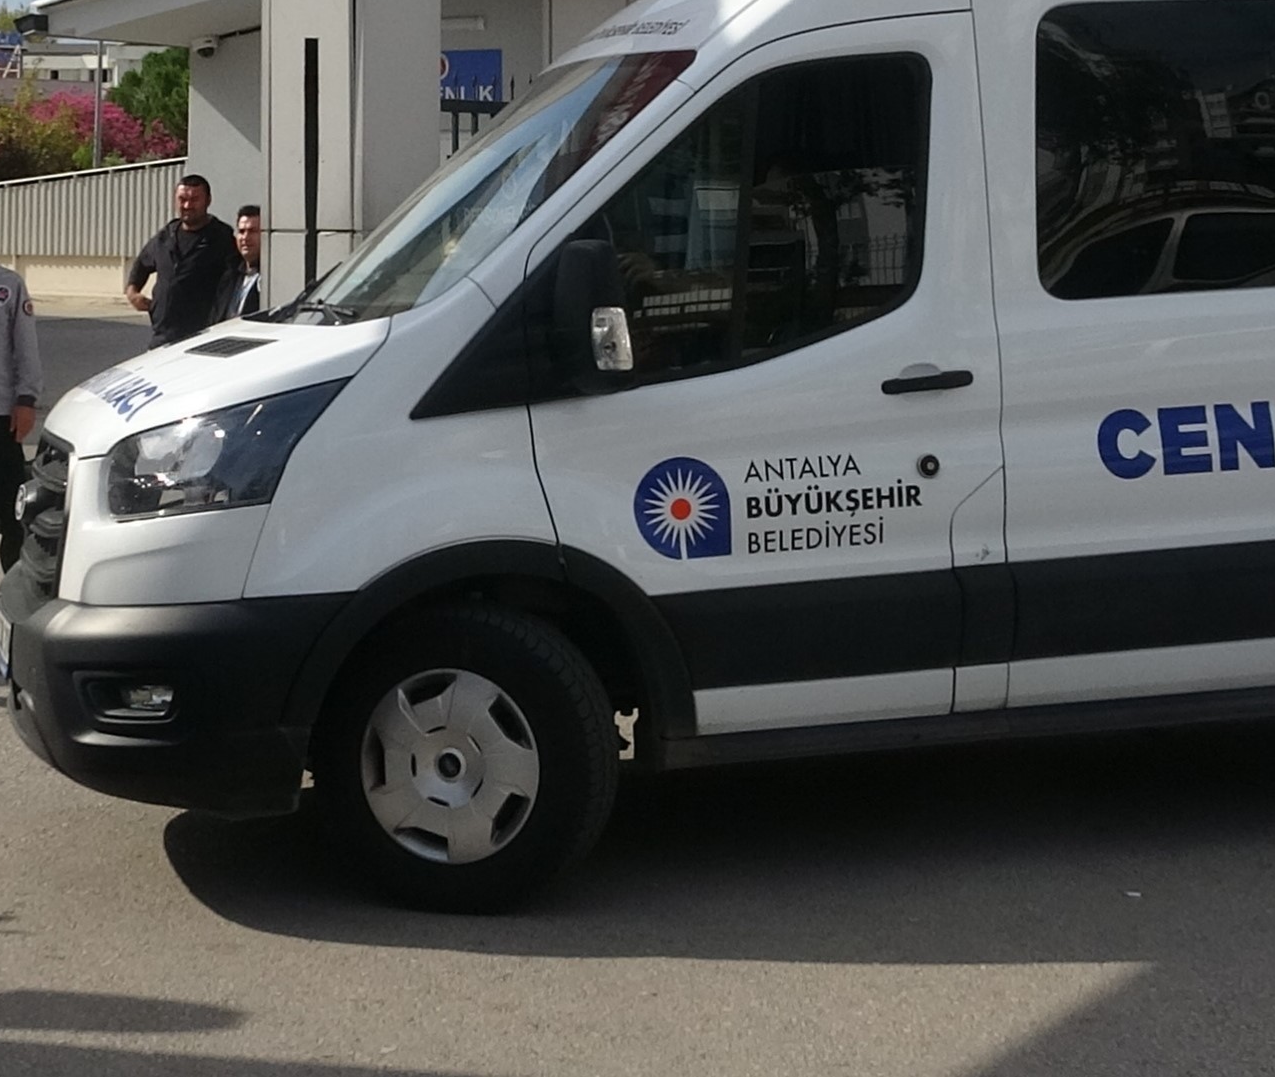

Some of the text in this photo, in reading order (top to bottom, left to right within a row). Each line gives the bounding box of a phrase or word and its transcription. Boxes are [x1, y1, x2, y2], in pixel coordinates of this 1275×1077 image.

[744, 453, 862, 484] ANTALYA
[745, 478, 923, 520] BÜYÜKŞEHİR
[747, 516, 885, 555] BELEDİYESİ
